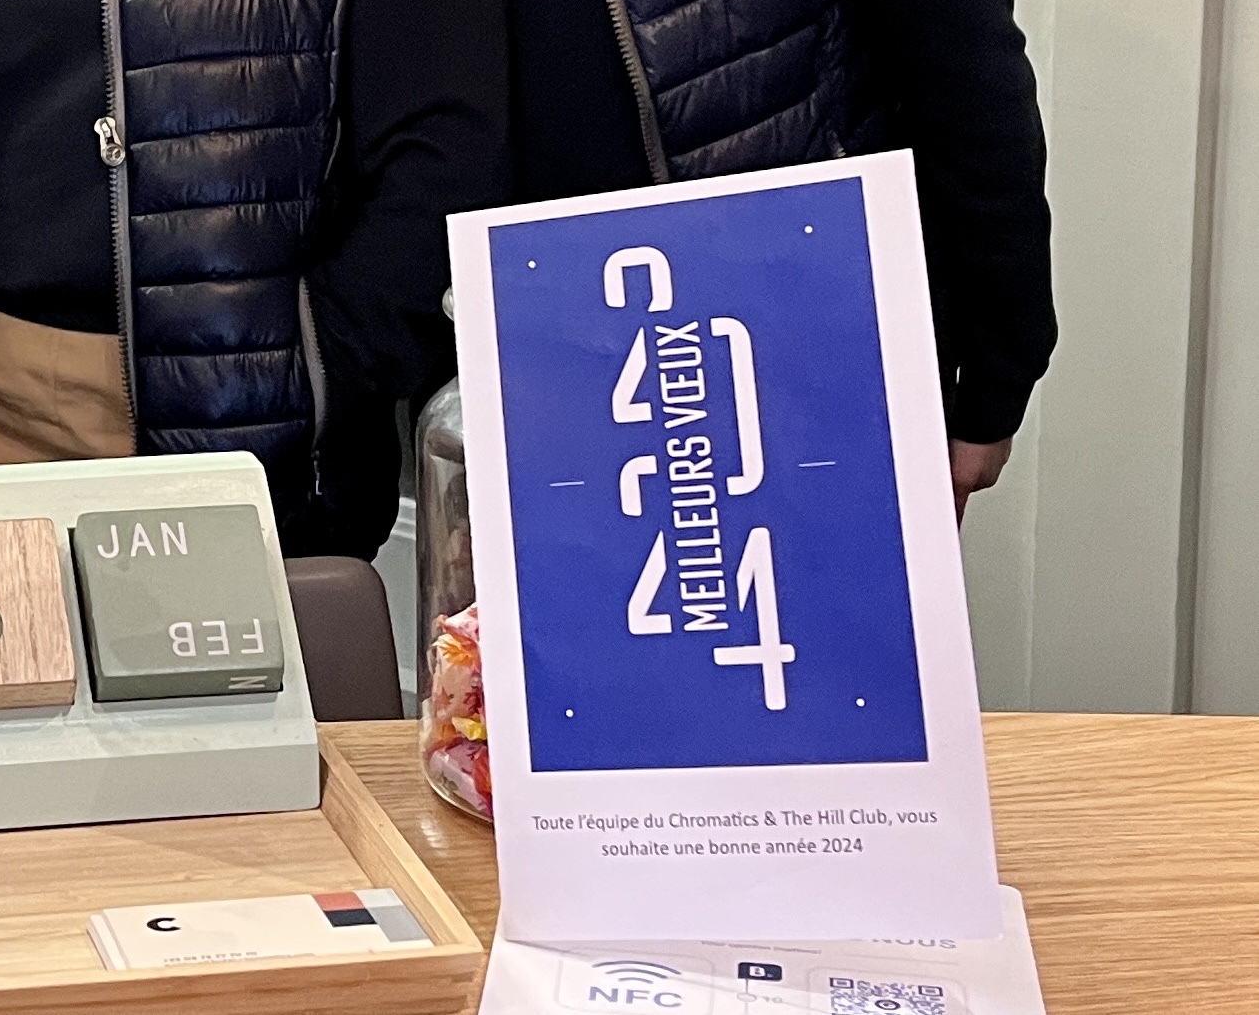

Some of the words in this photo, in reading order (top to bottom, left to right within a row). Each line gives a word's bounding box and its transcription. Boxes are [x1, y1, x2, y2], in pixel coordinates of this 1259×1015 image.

[96, 521, 190, 559] JAN
[666, 436, 729, 632] MEILLEURS
[168, 618, 266, 657] FEB
[532, 815, 574, 830] Toute
[643, 813, 664, 829] du
[669, 811, 759, 829] Chromatics
[763, 810, 778, 827] &
[780, 810, 813, 826] The
[817, 809, 845, 825] Hill
[849, 809, 893, 827] Club,
[897, 811, 938, 824] vous
[602, 840, 670, 856] souhaite
[674, 842, 705, 856] une
[709, 839, 761, 855] bonne
[765, 837, 817, 854] année
[821, 837, 864, 853] 2024
[146, 917, 181, 932] C
[588, 986, 683, 1008] NFC
